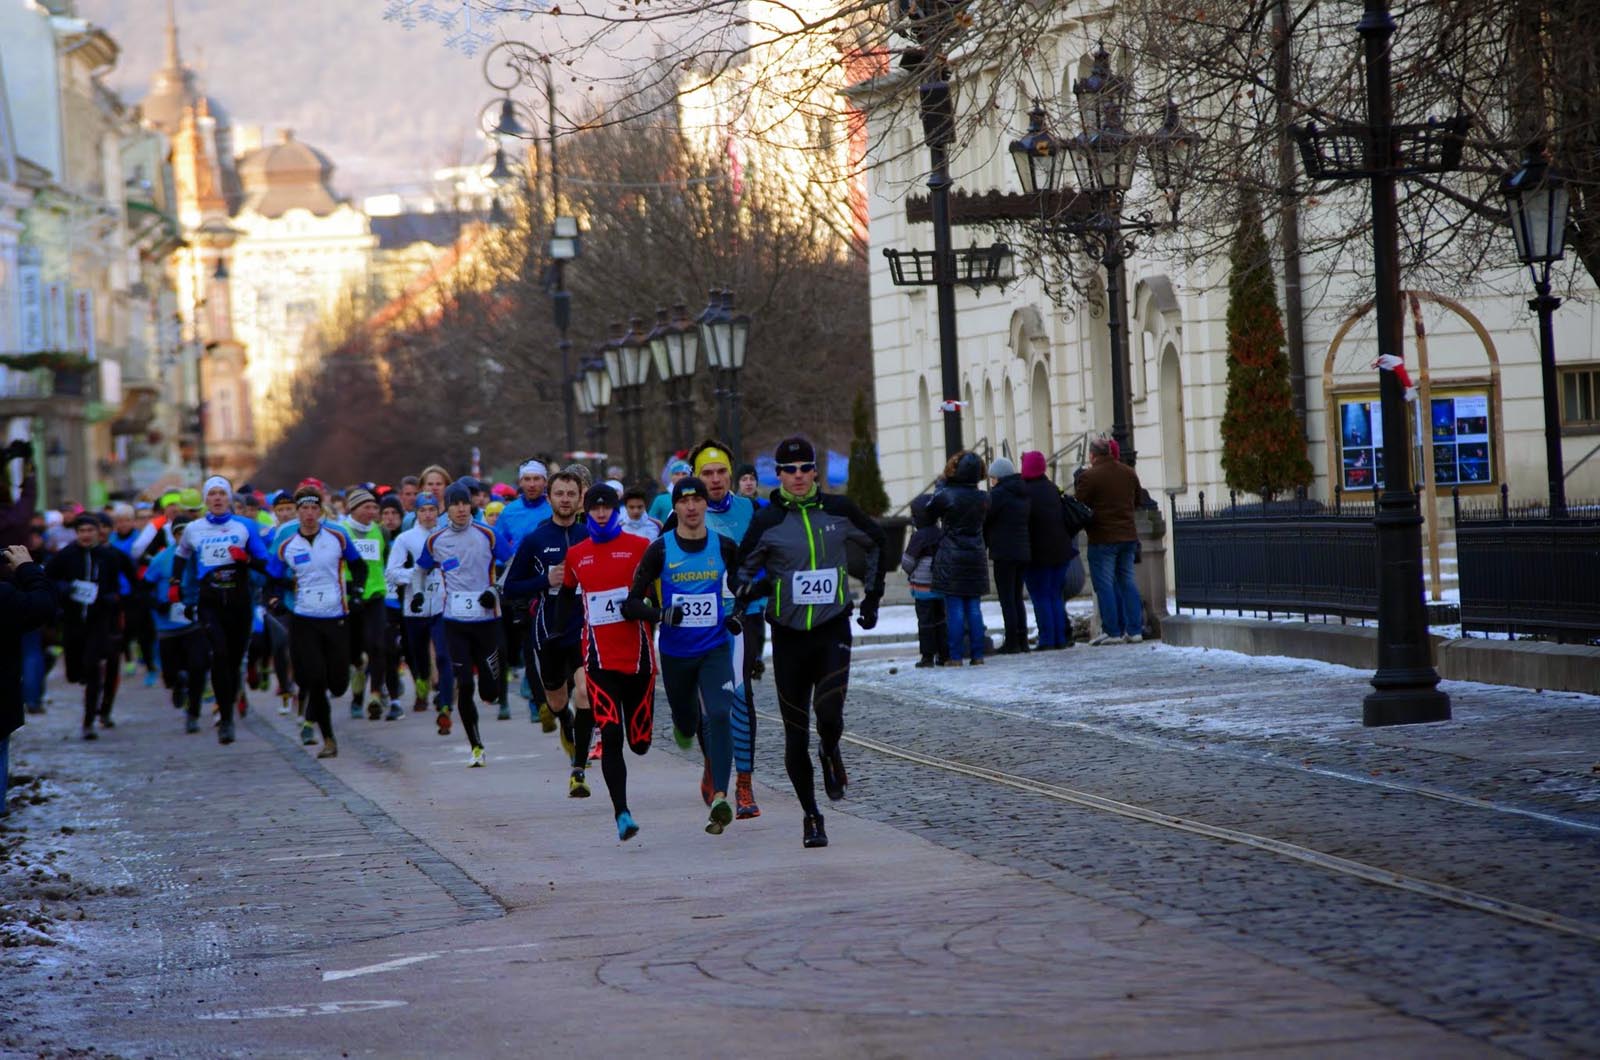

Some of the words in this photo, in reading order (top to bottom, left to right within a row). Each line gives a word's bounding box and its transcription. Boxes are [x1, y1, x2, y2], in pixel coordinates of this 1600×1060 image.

[212, 548, 226, 558] 42
[671, 570, 719, 583] UKRAINE
[801, 579, 832, 595] 240
[317, 592, 324, 602] 7
[465, 598, 473, 609] 3
[605, 600, 615, 613] 4
[682, 601, 711, 616] 332
